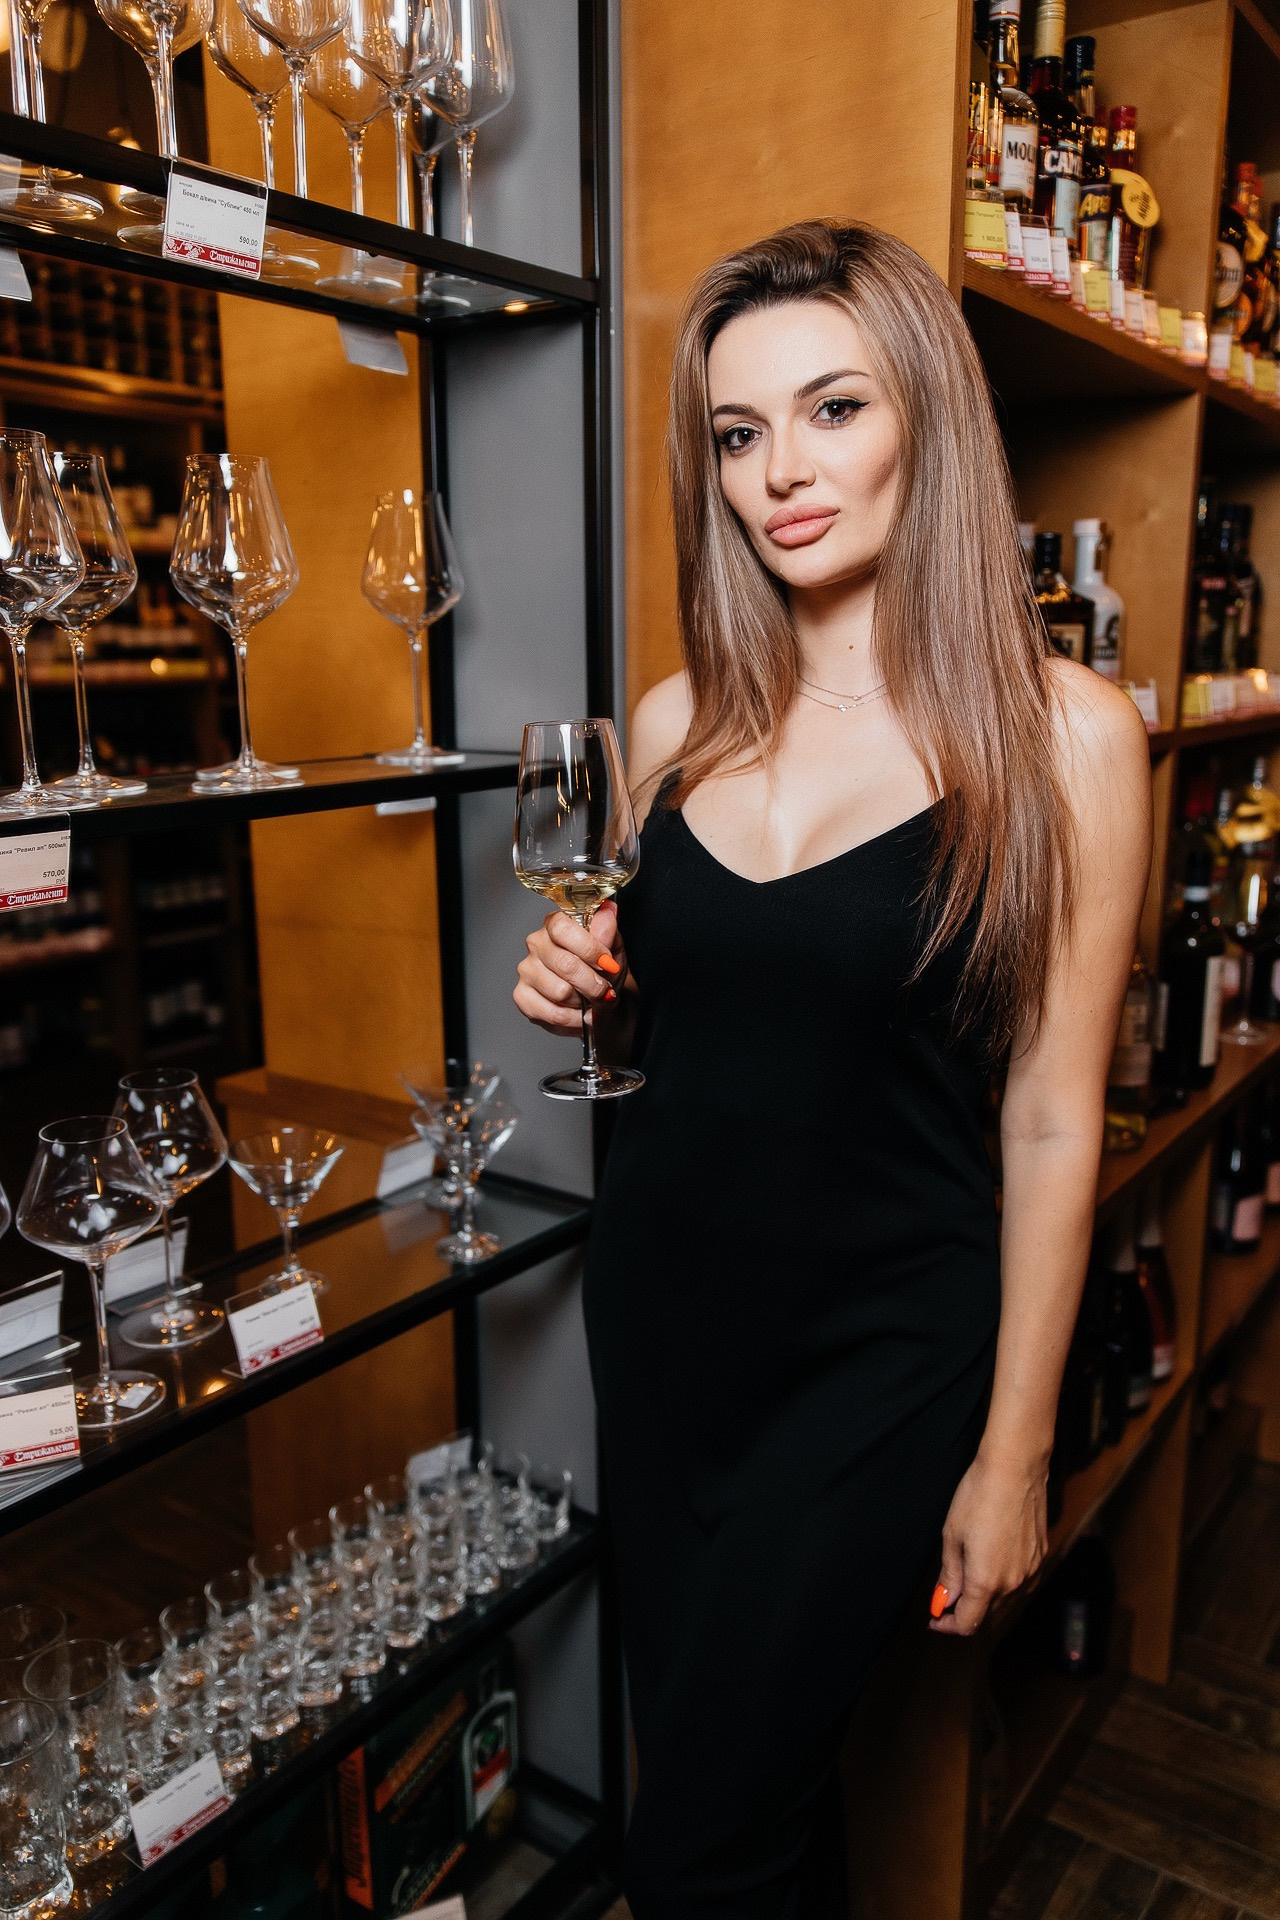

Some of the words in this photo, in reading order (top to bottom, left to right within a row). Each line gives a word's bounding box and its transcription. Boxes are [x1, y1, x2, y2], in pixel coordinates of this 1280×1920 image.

[182, 188, 199, 199] Бокал
[239, 235, 259, 247] 590,00
[42, 868, 66, 878] 570,00
